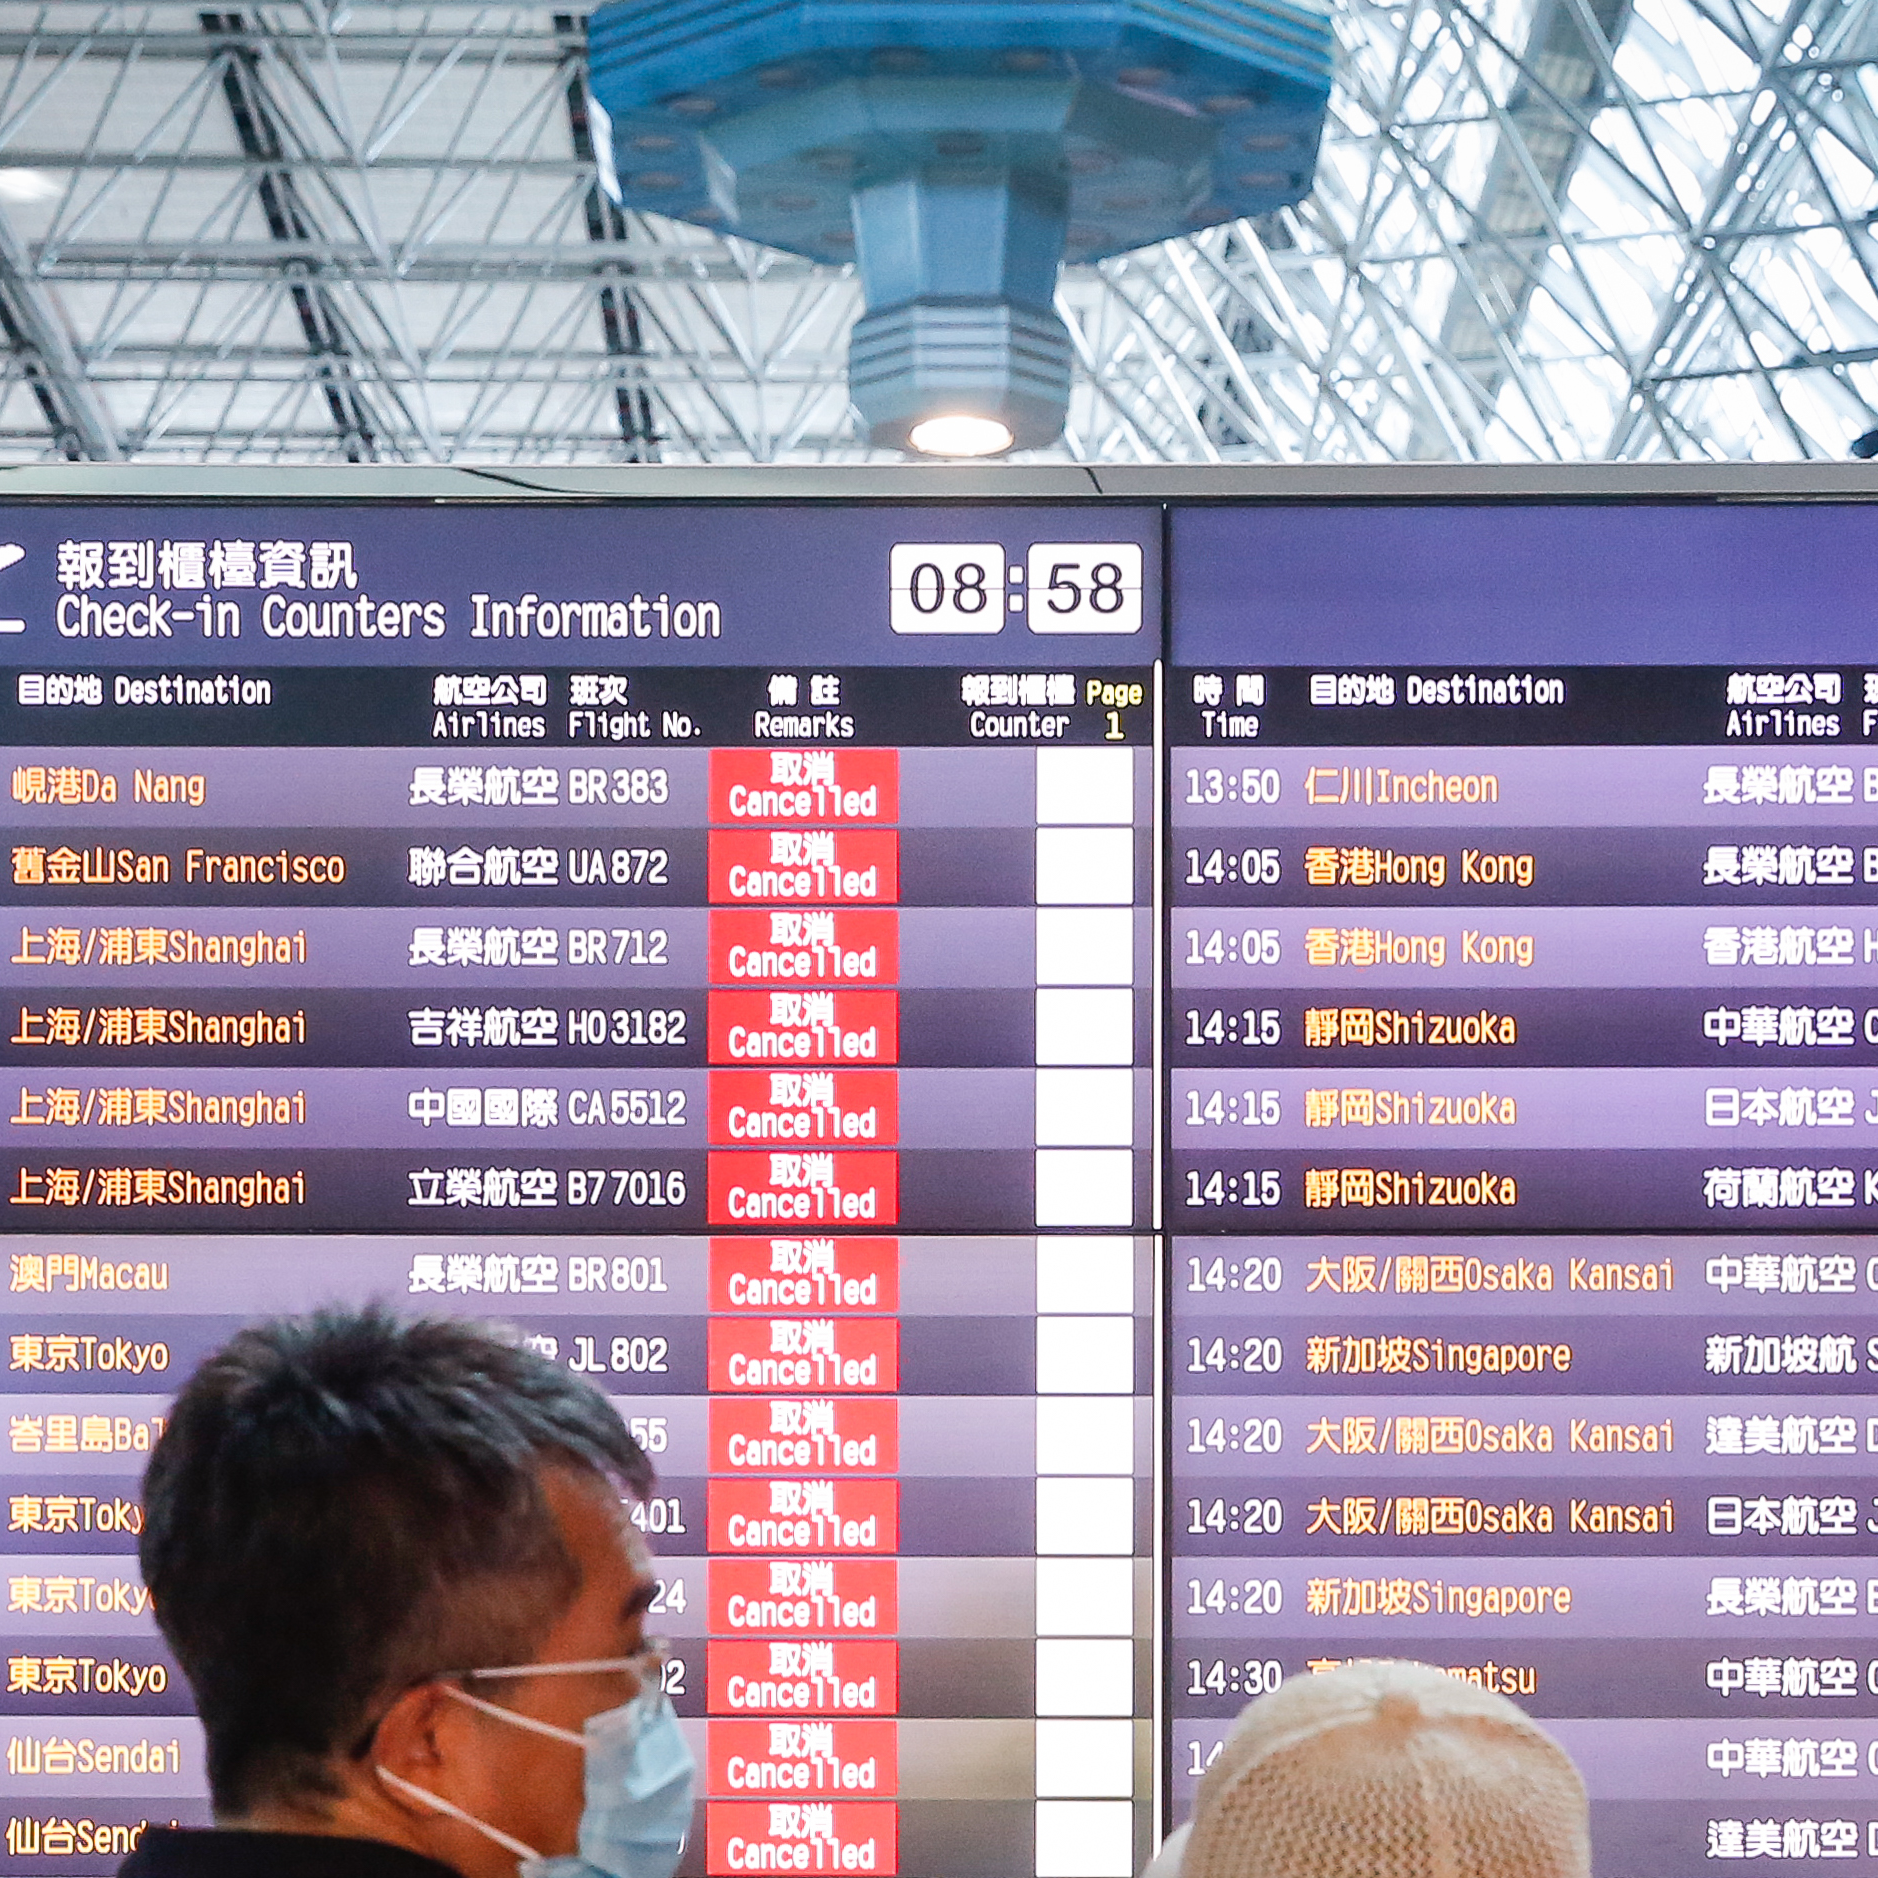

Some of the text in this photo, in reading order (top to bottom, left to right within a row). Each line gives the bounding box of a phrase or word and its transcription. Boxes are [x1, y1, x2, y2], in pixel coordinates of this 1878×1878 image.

[57, 541, 359, 590] 報到櫃檯資訊
[910, 563, 1124, 614] 08:58
[57, 594, 721, 637] Check-in Counters Information
[18, 673, 103, 706] 目的地
[114, 674, 272, 705] Destination
[433, 673, 548, 707] 航空公司
[569, 674, 628, 706] 班次
[1086, 680, 1143, 707] Page
[1310, 673, 1395, 706] 目的地
[1407, 673, 1565, 705] Destination
[1726, 672, 1842, 706] 航空公司
[432, 710, 546, 738] Airlines
[569, 711, 651, 741] Flight
[662, 710, 702, 738] No.
[755, 710, 855, 739] Remarks
[970, 710, 1071, 738] Counter
[1104, 711, 1125, 740] 1
[1201, 709, 1259, 738] Time
[1726, 709, 1841, 738] Airlines
[133, 769, 206, 807] Nang
[409, 766, 559, 806] 長榮航空
[770, 751, 834, 785] 取消
[1186, 769, 1280, 803] 13:50
[1703, 764, 1854, 805] 長榮航空
[729, 781, 877, 817] Cancelled
[185, 849, 346, 884] Francisco
[408, 846, 558, 886] 聯合航空
[1186, 849, 1280, 884] 14:05
[1461, 849, 1534, 887] Kong
[1703, 845, 1854, 885] 長榮航空
[409, 926, 558, 967] 長榮航空
[1186, 930, 1280, 964] 14:05
[1461, 930, 1535, 968] Kong
[1703, 925, 1854, 965] 香港航空
[408, 1007, 558, 1047] 吉祥航空
[770, 991, 834, 1025] 取消
[1187, 1010, 1280, 1044] 14:15
[1704, 1006, 1854, 1046] 中華航空
[729, 1021, 876, 1058] Cancelled
[409, 1087, 558, 1127] 中國國際
[1186, 1090, 1280, 1125] 14:15
[1706, 1086, 1855, 1126] 日本航空
[408, 1167, 557, 1207] 立榮航空
[1187, 1171, 1280, 1205] 14:15
[1704, 1167, 1854, 1207] 荷蘭航空
[408, 1253, 559, 1294] 長榮航空
[1188, 1257, 1282, 1292] 14:20
[1569, 1257, 1673, 1292] Kansai
[1706, 1254, 1856, 1293] 中華航空
[770, 1319, 834, 1352] 取消
[1188, 1338, 1282, 1372] 14:20
[1706, 1334, 1857, 1374] 新加坡航
[729, 1348, 876, 1385] Cancelled
[1188, 1418, 1282, 1453] 14:20
[1569, 1417, 1673, 1453] Kansai
[1705, 1414, 1857, 1454] 達美航空
[1188, 1499, 1282, 1533] 14:20
[1569, 1498, 1673, 1534] Kansai
[1708, 1496, 1857, 1535] 日本航空
[1188, 1580, 1282, 1614] 14:20
[1706, 1576, 1857, 1616] 長榮航空
[1188, 1657, 1857, 1697] 14:30 中華航空
[1707, 1737, 1858, 1778] 中華航空
[1707, 1818, 1858, 1858] 達美航空
